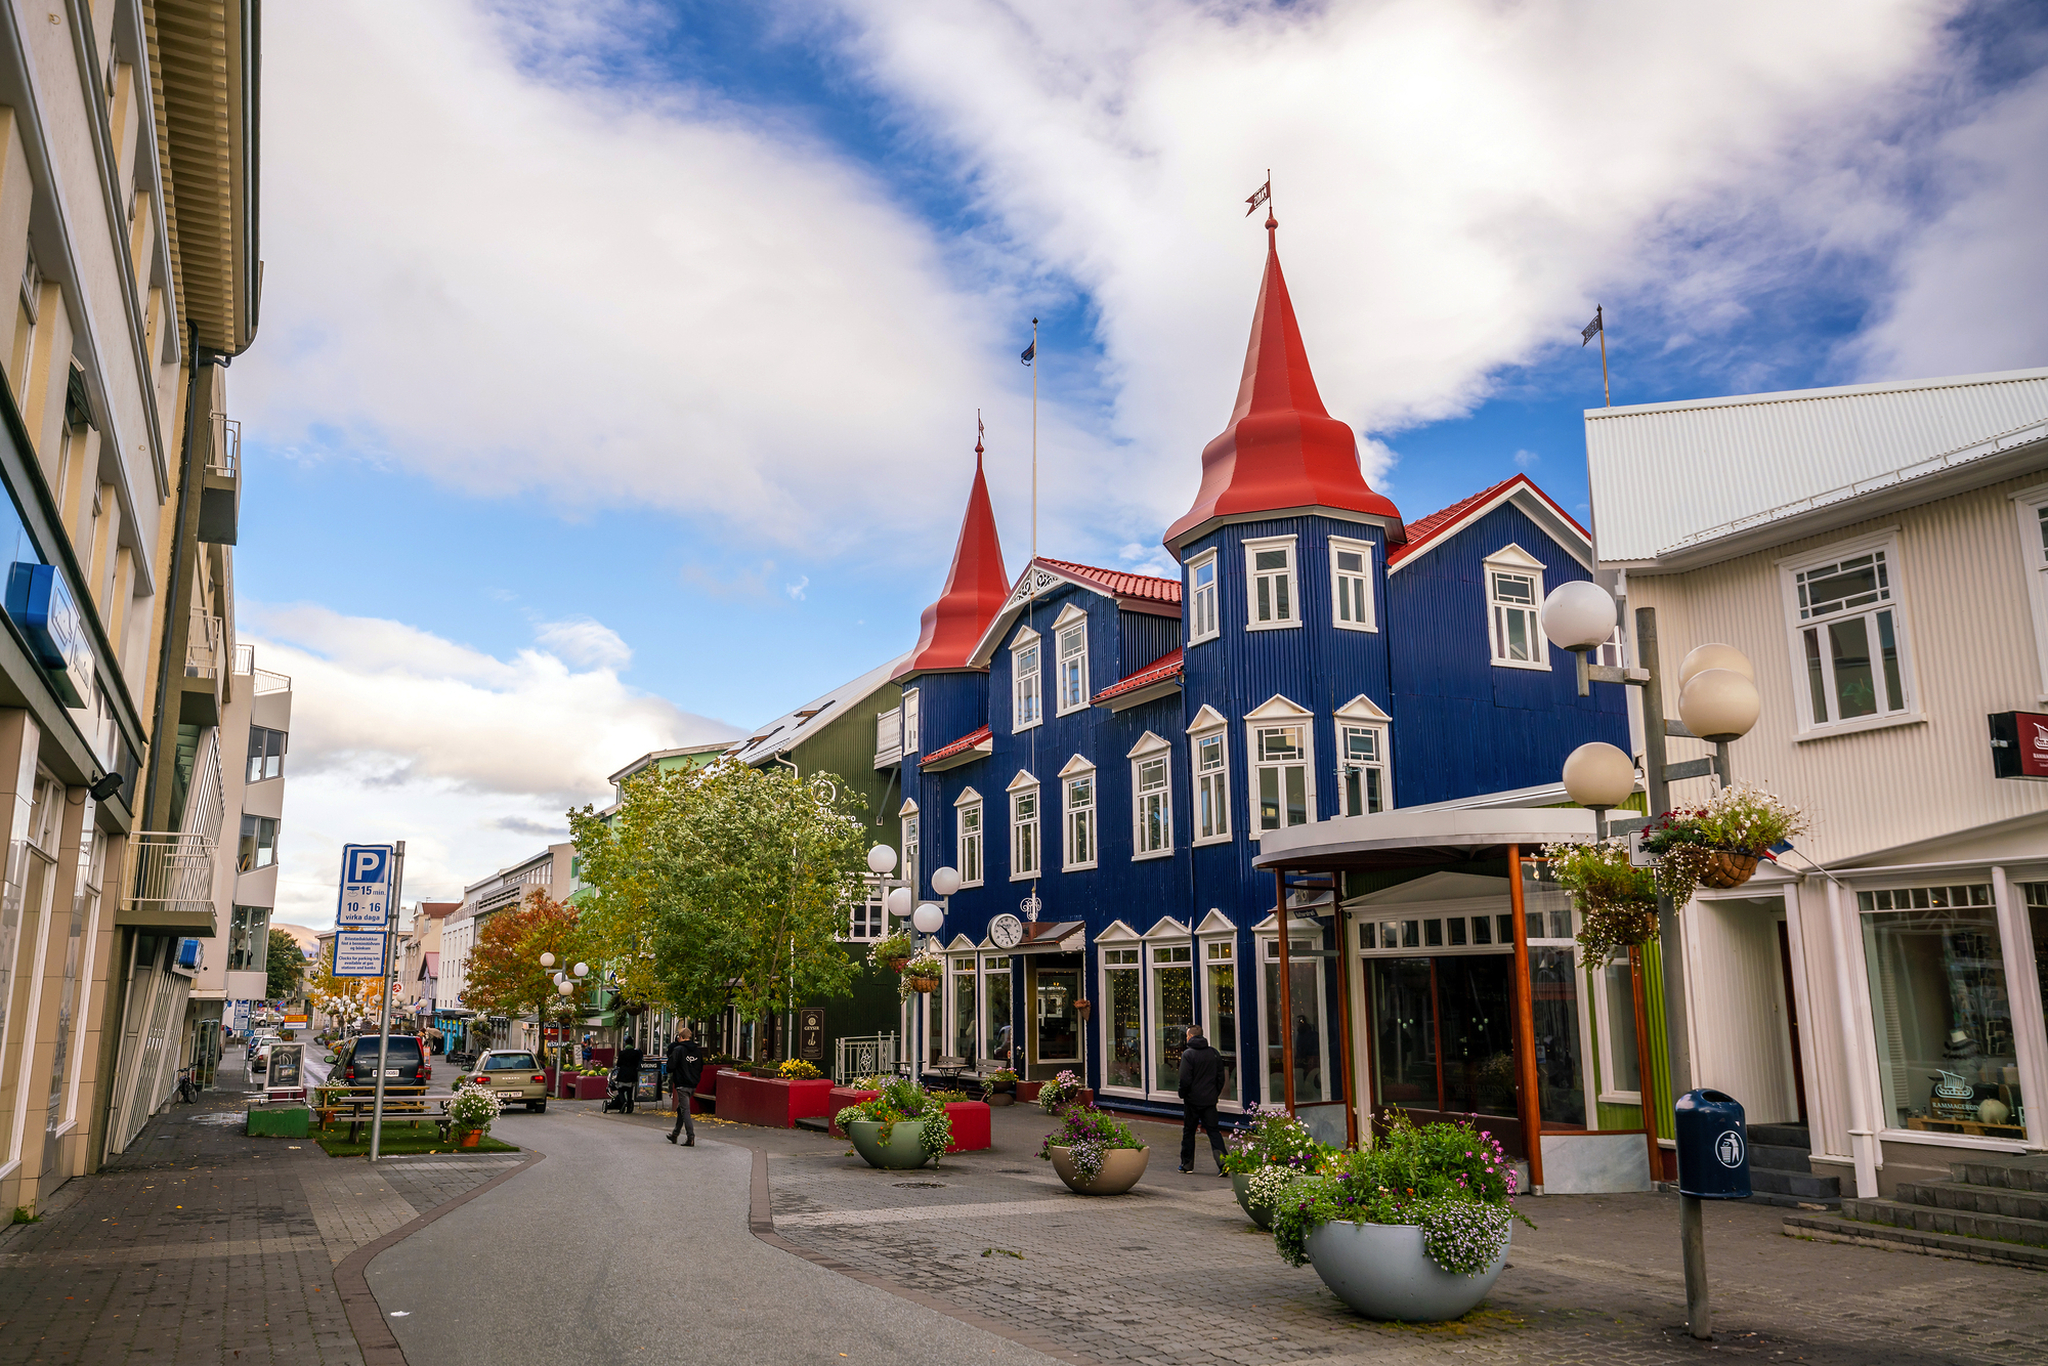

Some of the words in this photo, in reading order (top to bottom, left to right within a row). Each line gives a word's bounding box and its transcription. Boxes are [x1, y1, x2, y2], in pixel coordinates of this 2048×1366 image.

[355, 852, 380, 880] P
[360, 886, 372, 896] 15
[347, 902, 358, 912] 10
[370, 902, 381, 912] 16
[364, 914, 380, 922] daga
